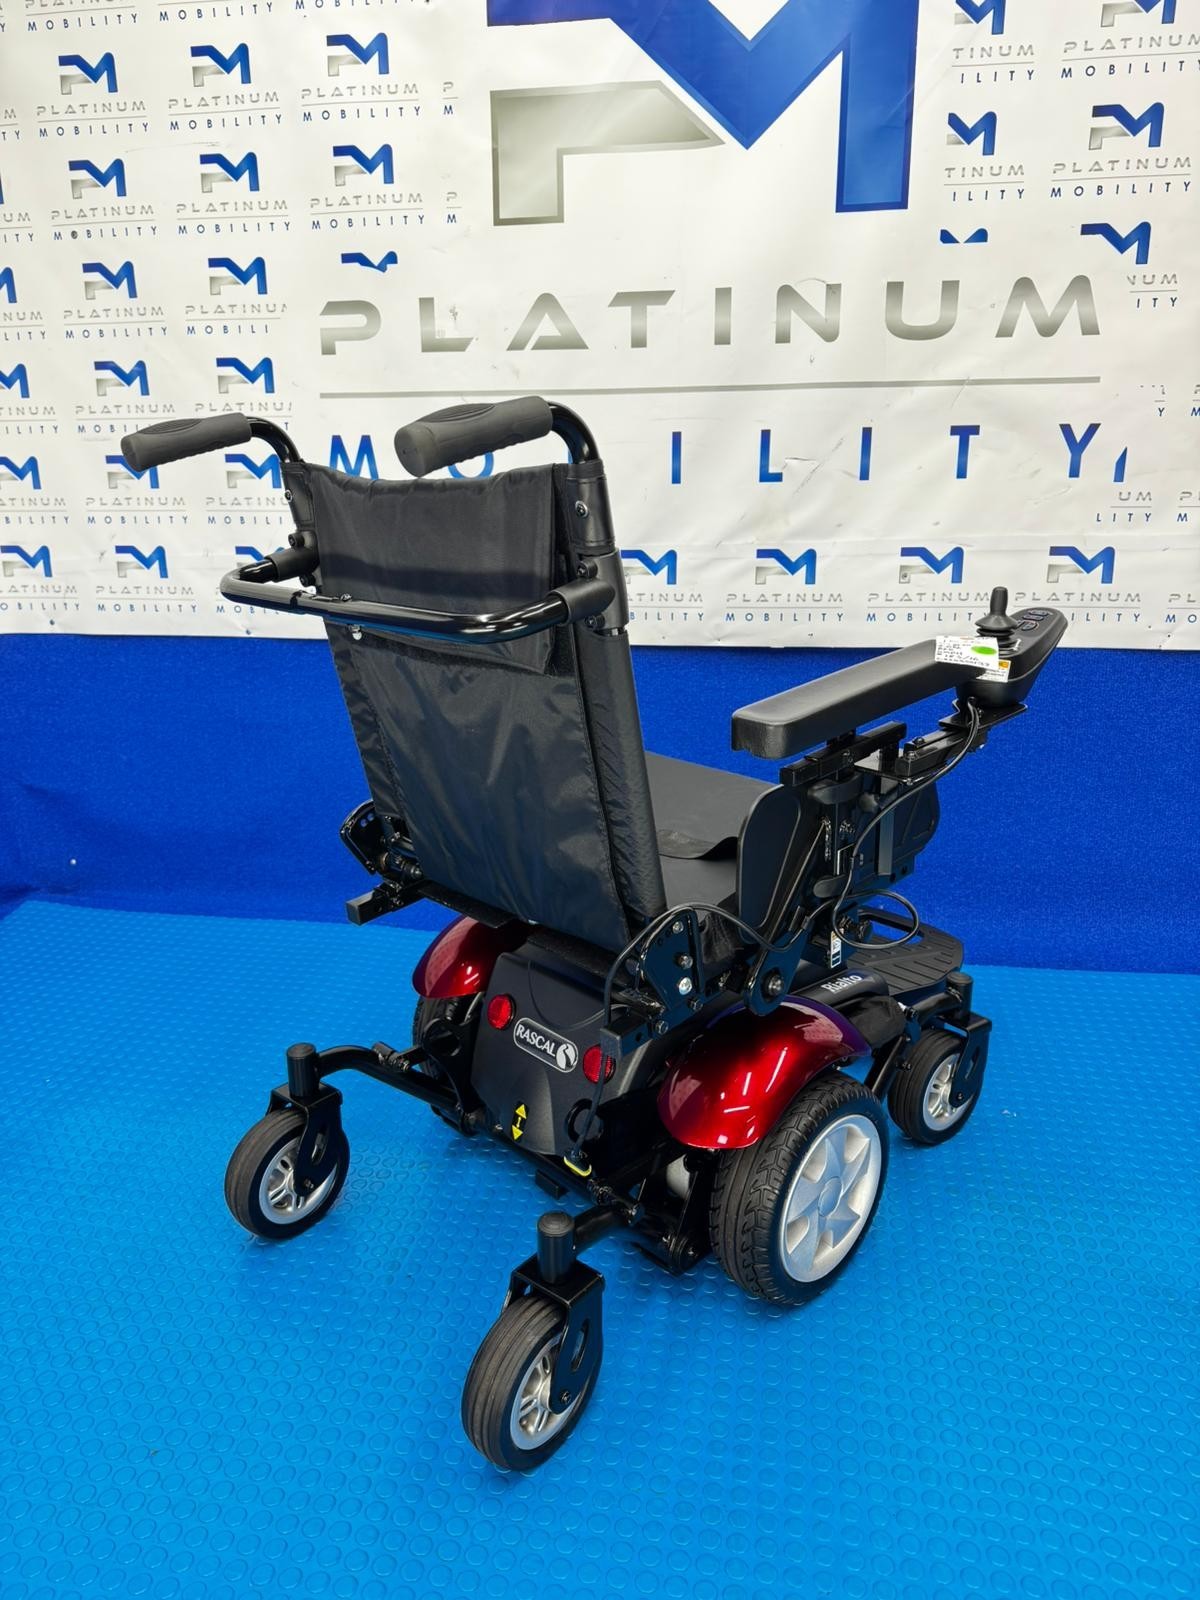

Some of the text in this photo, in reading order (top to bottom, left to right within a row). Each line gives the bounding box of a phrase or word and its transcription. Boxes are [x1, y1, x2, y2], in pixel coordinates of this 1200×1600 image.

[159, 2, 273, 21] MOBILITY
[28, 13, 138, 31] MOBILITY
[301, 83, 418, 99] PLATINUM
[168, 91, 279, 109] PLATINUM
[37, 101, 146, 116] PLATINUM
[303, 106, 420, 121] MOBILITY
[170, 114, 281, 130] MOBILITY
[39, 122, 148, 138] MOBILITY
[1053, 157, 1191, 174] PLATINUM
[1050, 181, 1191, 198] MOBILITY
[176, 200, 288, 213] PLATINUM
[310, 193, 423, 208] PLATINUM
[51, 205, 154, 220] PLATINUM
[178, 221, 290, 234] MOBILITY
[312, 215, 425, 230] MOBILITY
[63, 306, 164, 319] PLATINUM
[320, 275, 1100, 355] PLATINUM
[65, 327, 167, 339] MOBILITY
[75, 404, 175, 415] PLATINUM
[85, 497, 186, 506] PLATINUM
[88, 515, 188, 524] MOBILITY
[96, 585, 194, 595] PLATINUM
[726, 593, 843, 602] PLATINUM
[868, 592, 989, 602] PLATINUM
[1015, 592, 1141, 602] PLATINUM
[97, 603, 197, 613] MOBILITY
[725, 613, 843, 621] MOBILITY
[821, 974, 863, 994] Rialto
[516, 1024, 556, 1057] RASCAL
